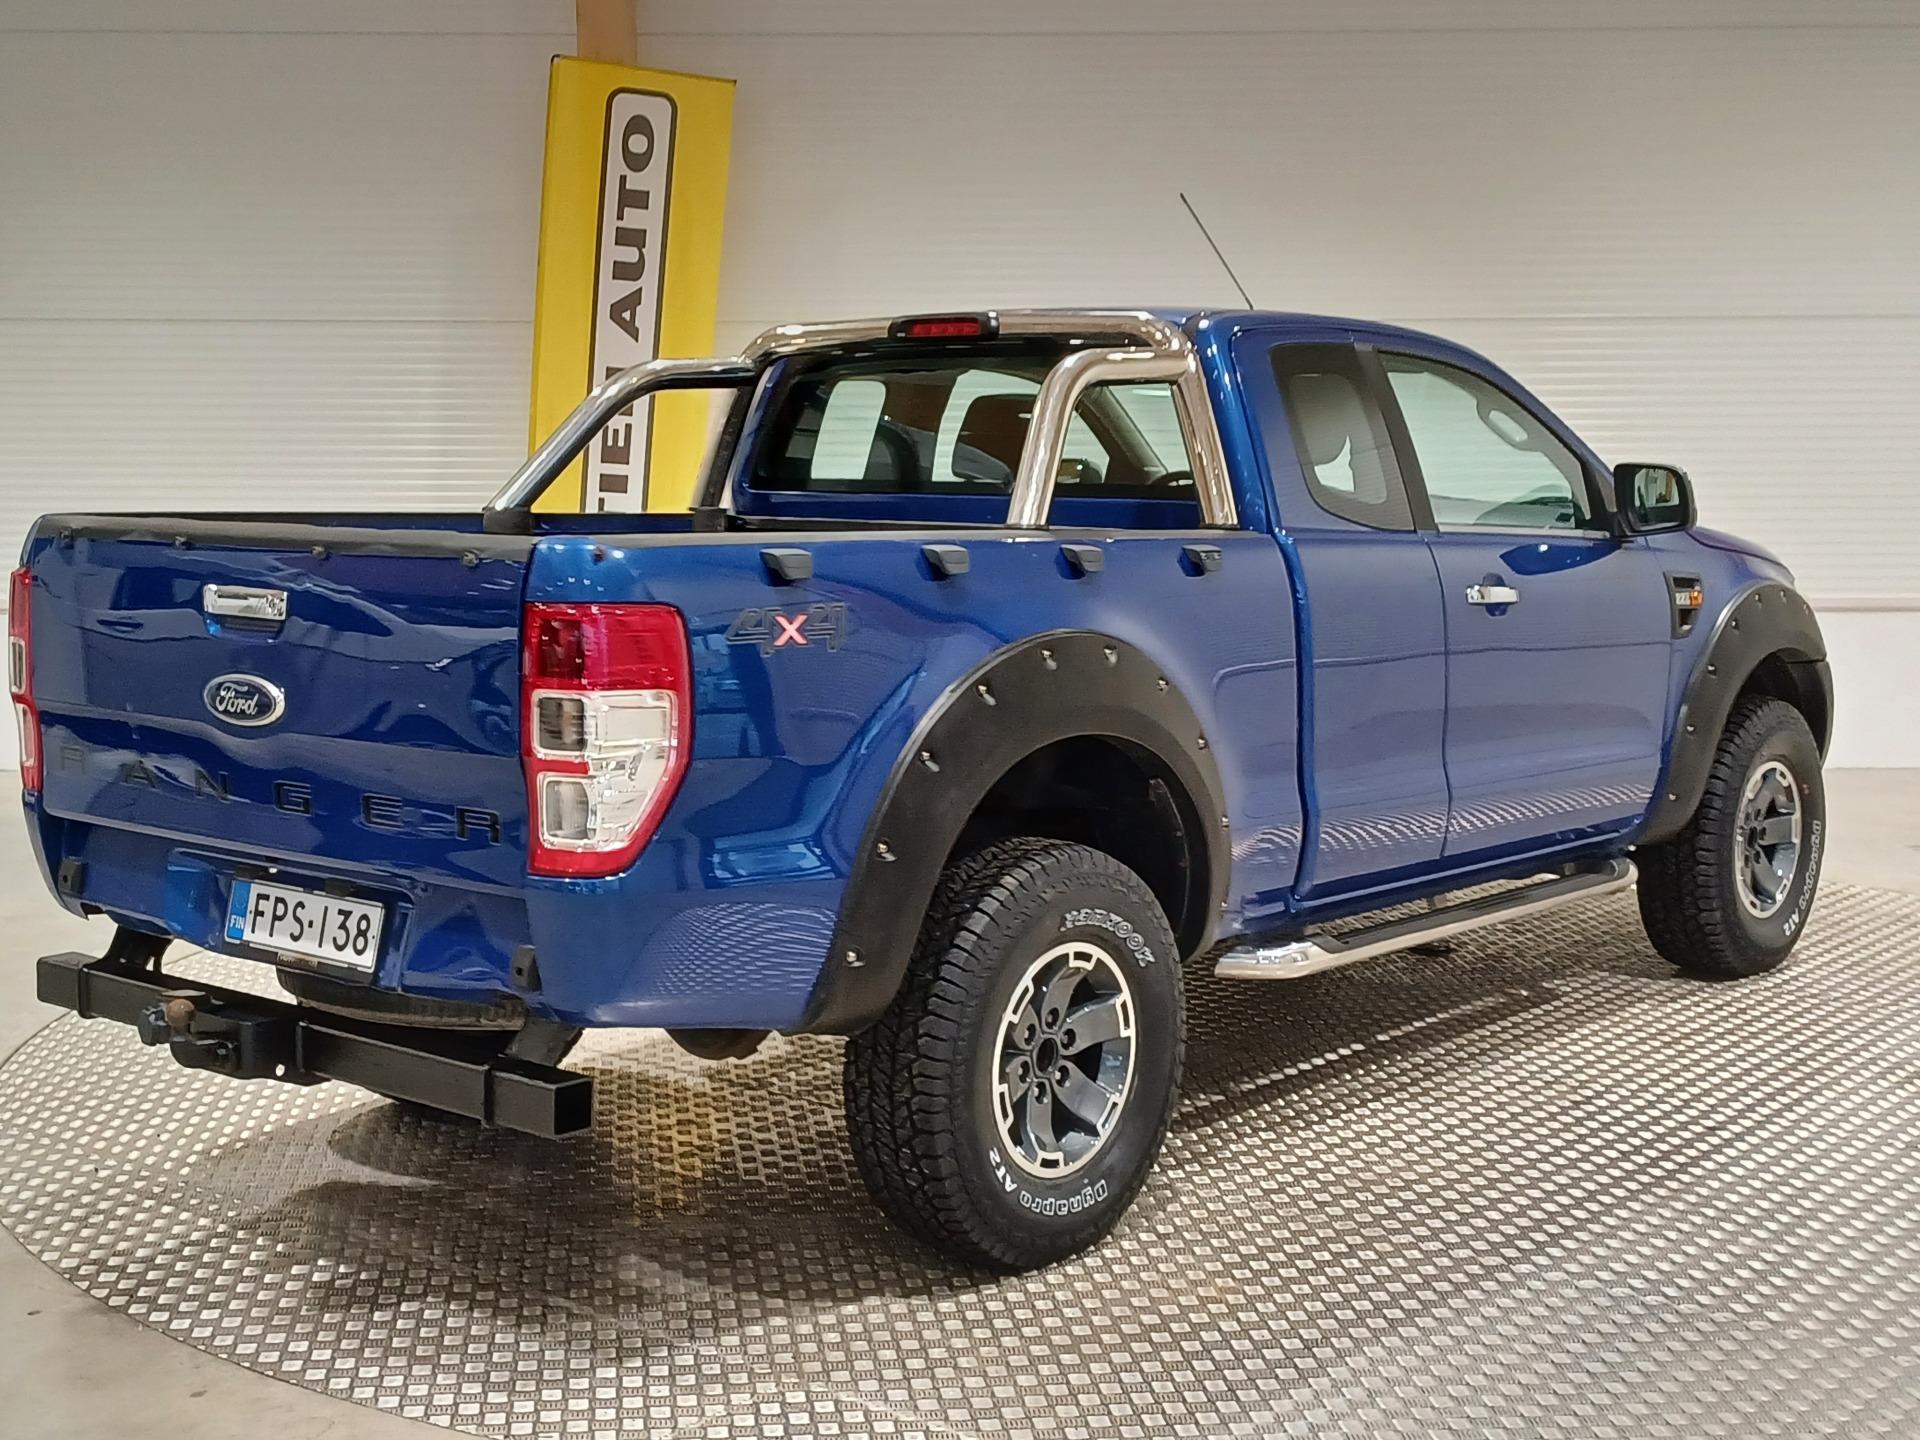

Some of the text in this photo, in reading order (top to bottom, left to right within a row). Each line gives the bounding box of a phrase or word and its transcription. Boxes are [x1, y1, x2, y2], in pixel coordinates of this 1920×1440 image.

[610, 114, 655, 343] AUTO
[215, 682, 259, 715] Ford
[59, 745, 501, 846] RANGER
[230, 914, 245, 930] FIN
[251, 893, 371, 956] FPS-138
[989, 1147, 1108, 1216] Dynapro AT2
